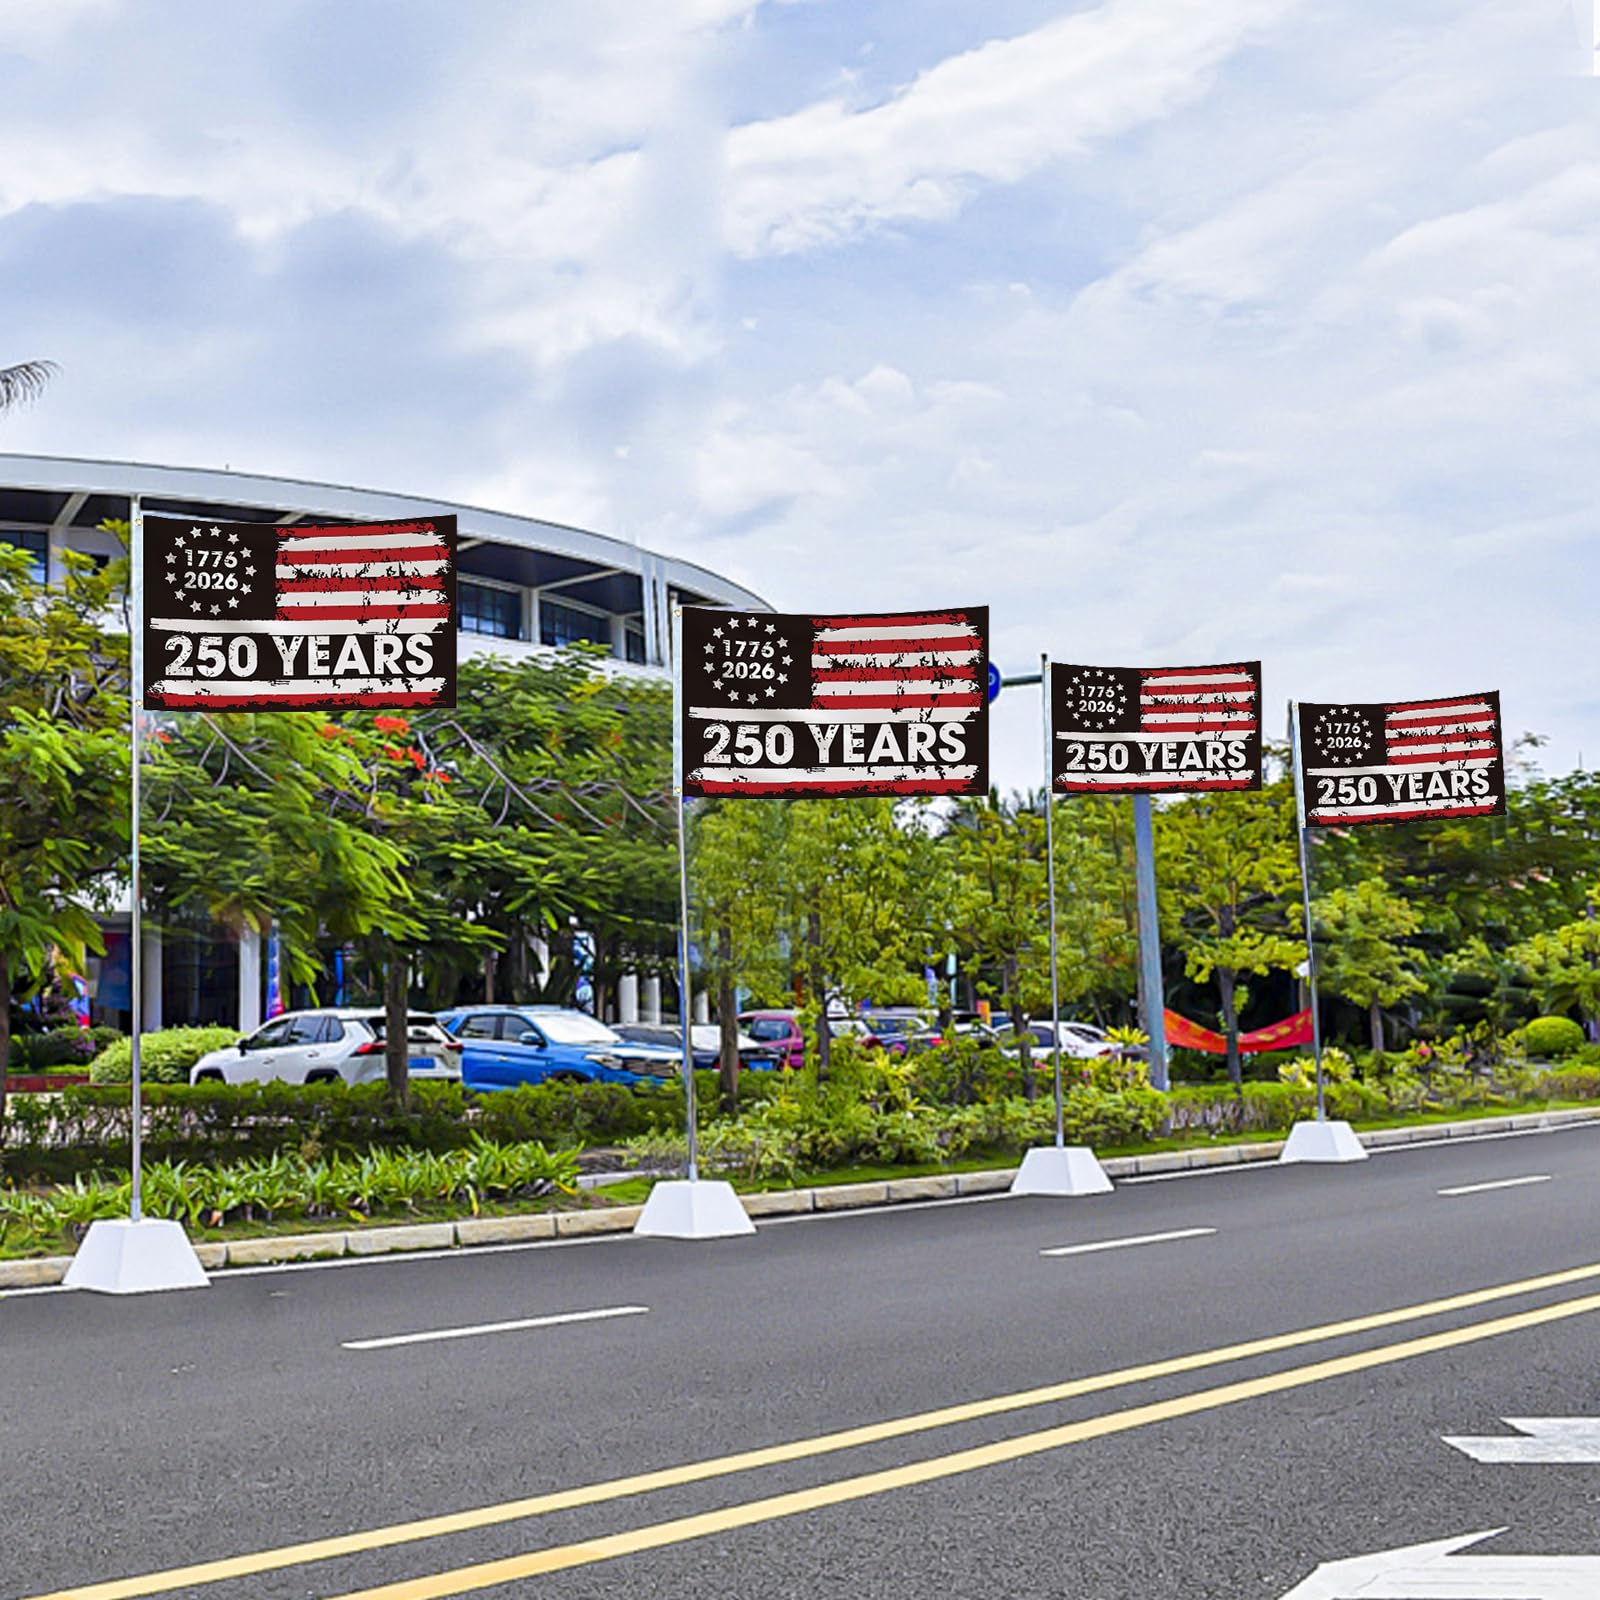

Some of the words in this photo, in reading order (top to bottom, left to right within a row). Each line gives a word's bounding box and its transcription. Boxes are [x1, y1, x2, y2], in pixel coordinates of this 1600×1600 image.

[185, 549, 239, 569] 1776
[184, 571, 239, 590] 2026
[164, 635, 258, 678] 250
[272, 634, 434, 676] YEARS
[723, 639, 775, 658] 1776
[722, 661, 775, 680] 2026
[1079, 685, 1115, 698] 1776
[1079, 700, 1115, 713] 2026
[1326, 722, 1361, 734] 1776
[703, 724, 795, 765] 250
[807, 722, 967, 764] YEARS
[1326, 736, 1362, 749] 2026
[1066, 743, 1129, 771] 250
[1138, 741, 1246, 770] YEARS
[1317, 778, 1377, 805] 250
[1385, 769, 1490, 801] YEARS
